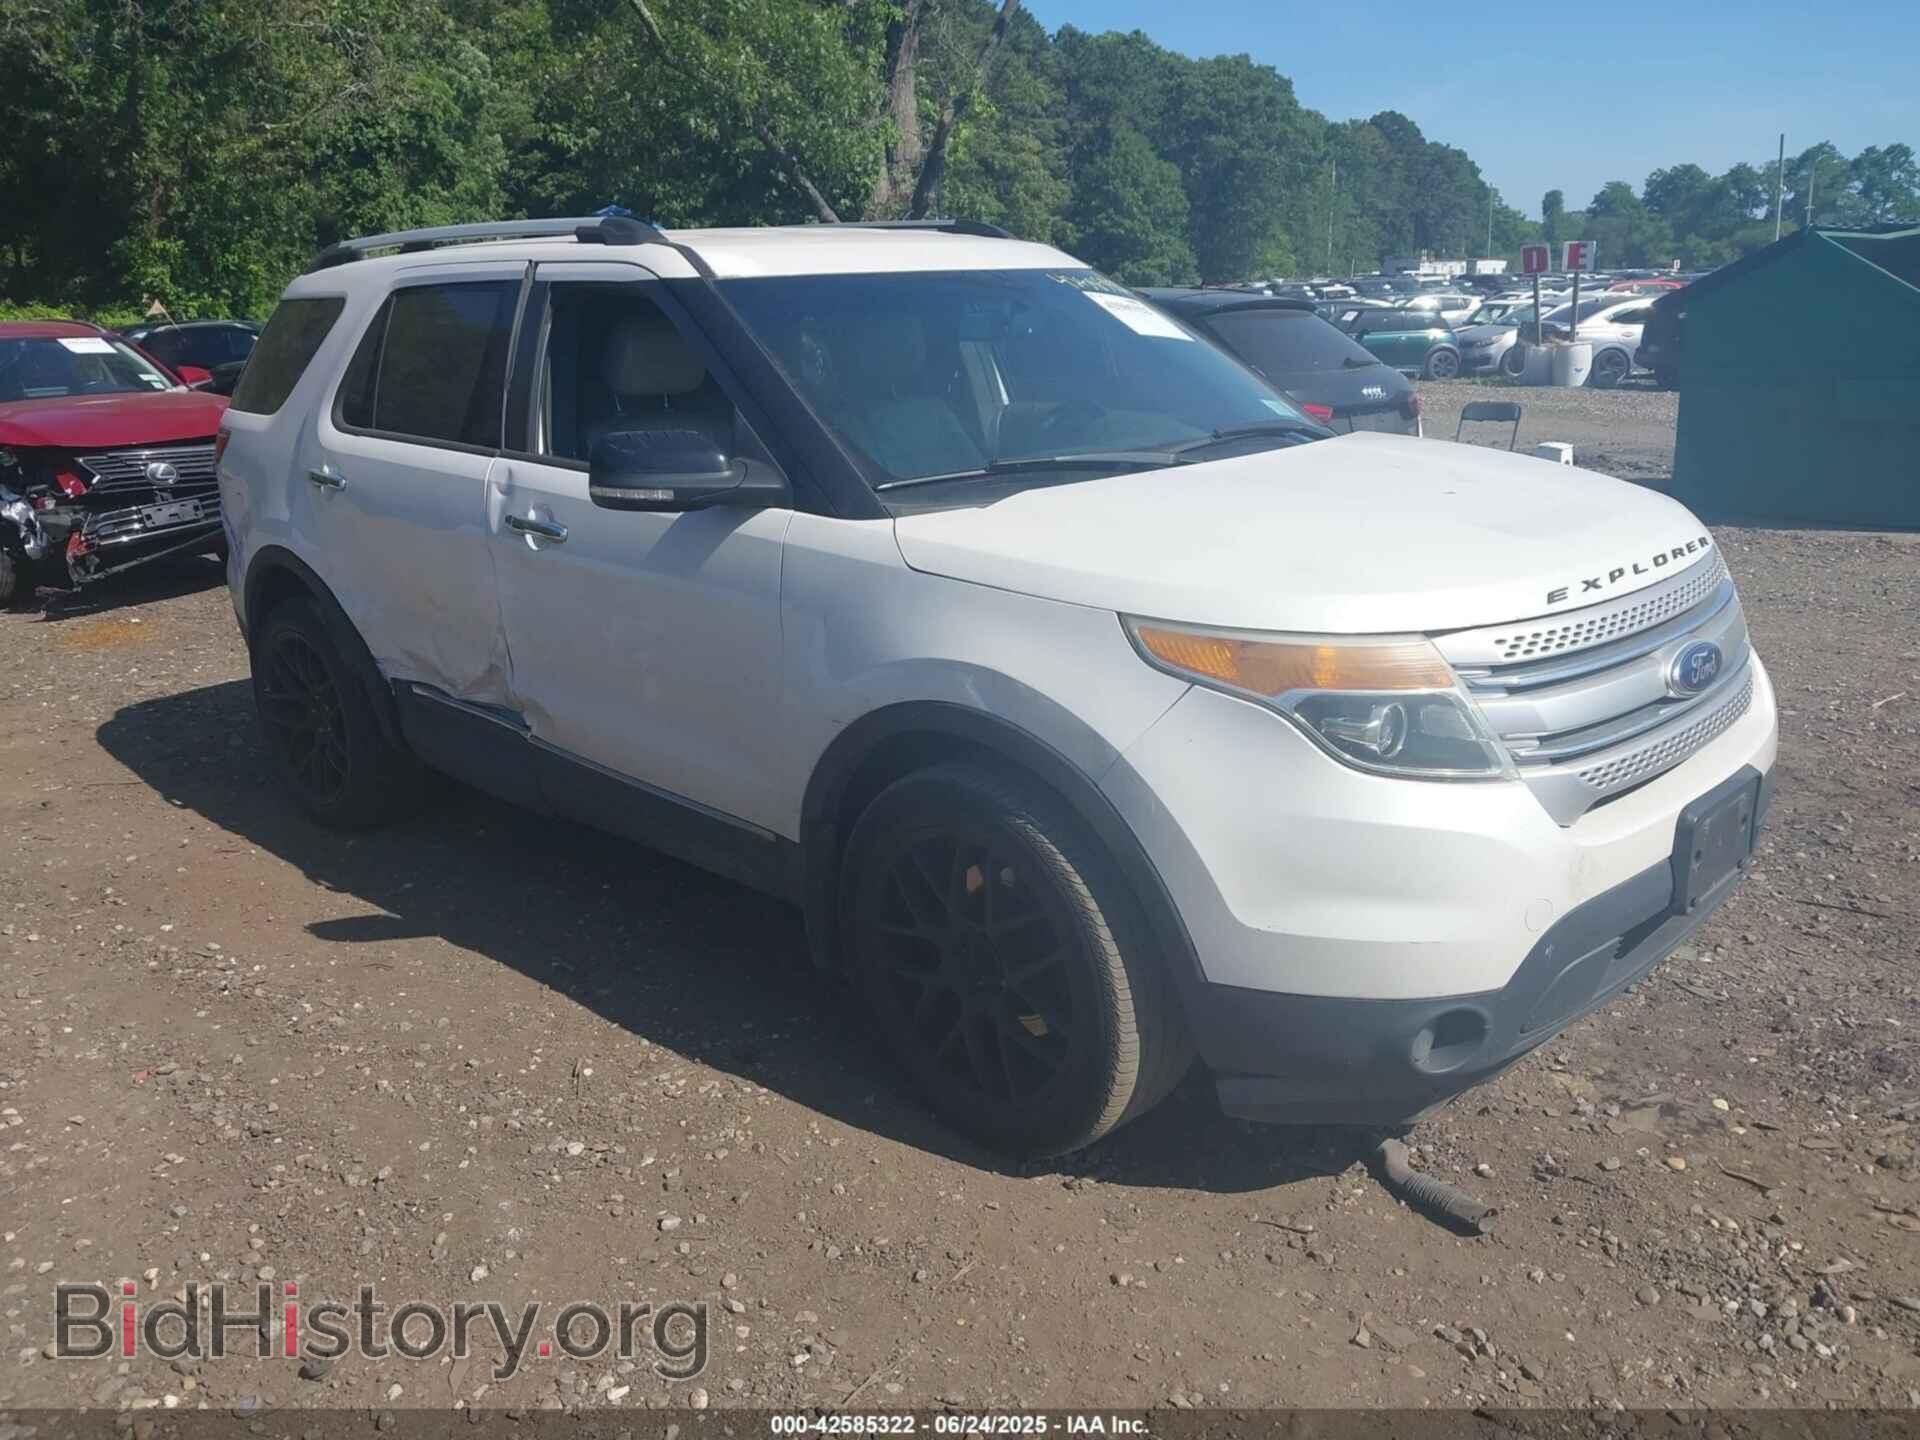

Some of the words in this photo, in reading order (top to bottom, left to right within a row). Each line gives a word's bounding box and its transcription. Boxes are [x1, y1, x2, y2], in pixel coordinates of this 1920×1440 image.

[1565, 242, 1588, 271] E
[1547, 536, 1709, 605] EXPLORER
[1691, 651, 1717, 684] Ford
